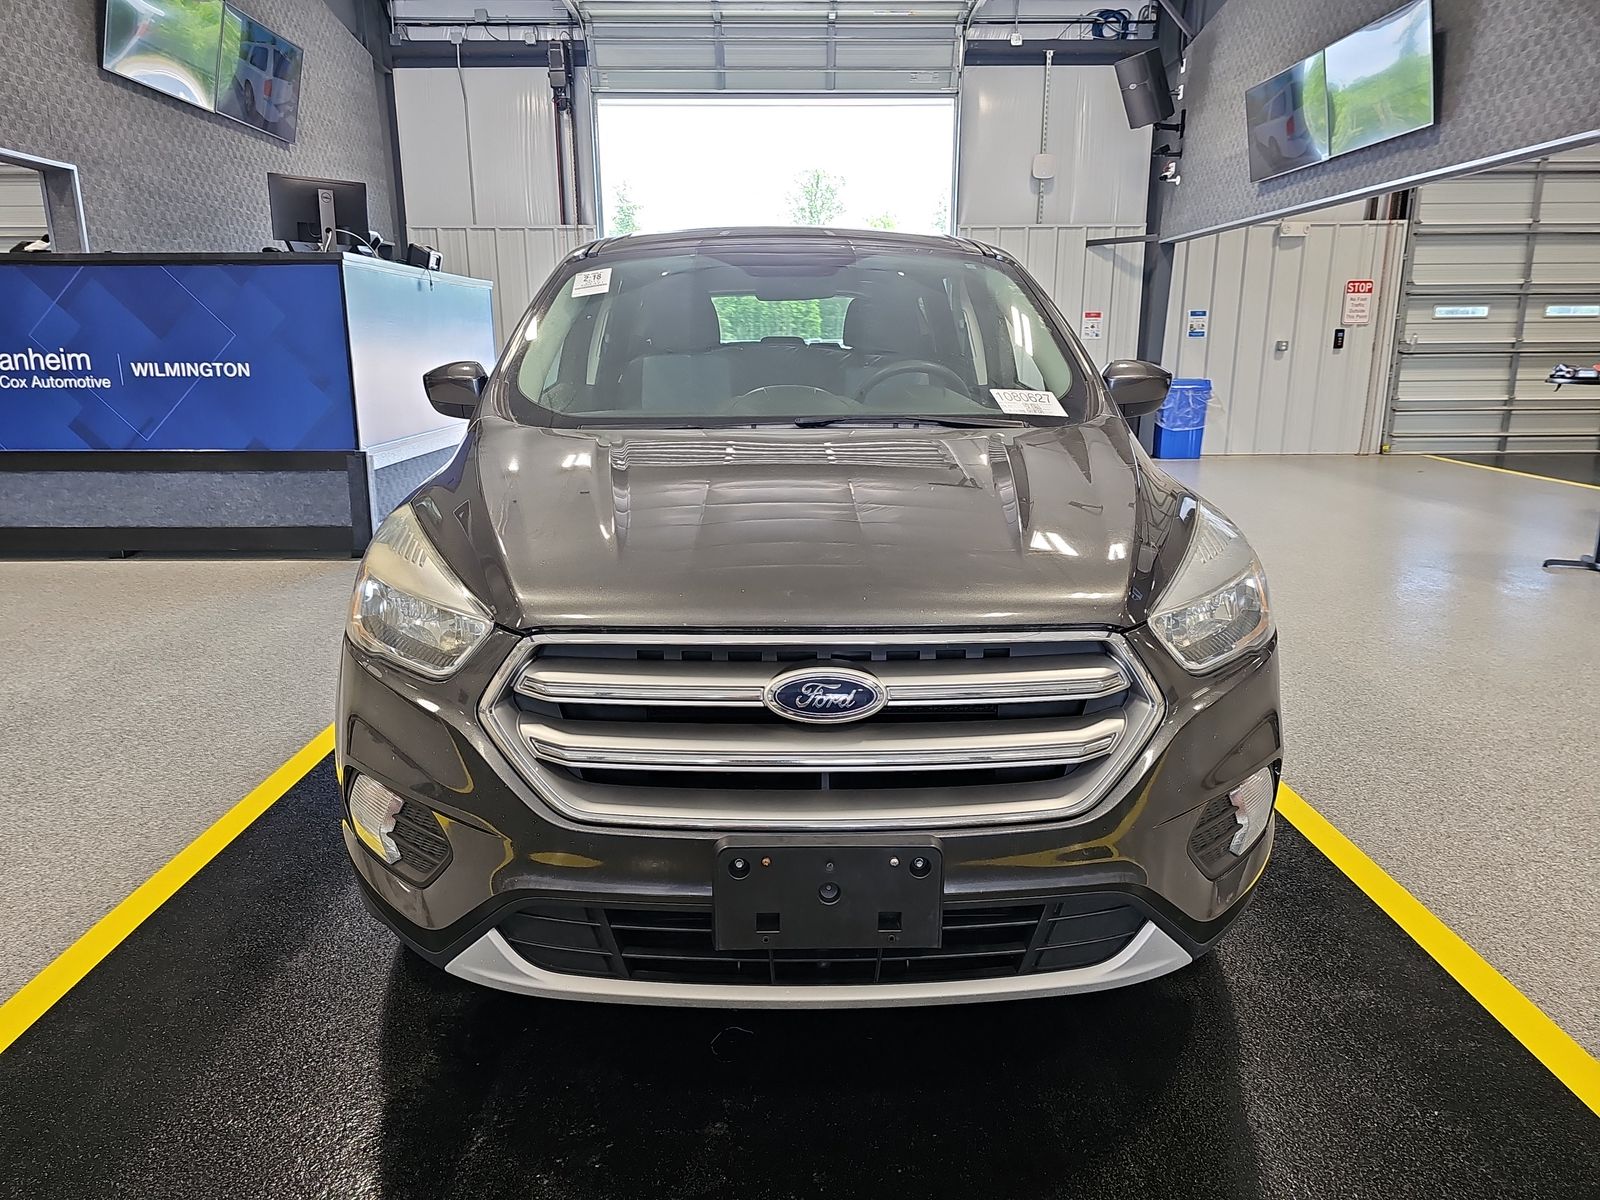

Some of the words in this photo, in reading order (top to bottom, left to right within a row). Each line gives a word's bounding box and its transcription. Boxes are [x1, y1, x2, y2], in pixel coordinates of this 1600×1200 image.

[1347, 282, 1373, 293] STOP
[130, 362, 251, 378] WILMINGTON
[0, 375, 28, 389] Cox
[31, 375, 112, 389] Automotive
[996, 391, 1051, 403] 1080627
[795, 682, 857, 709] Ford
